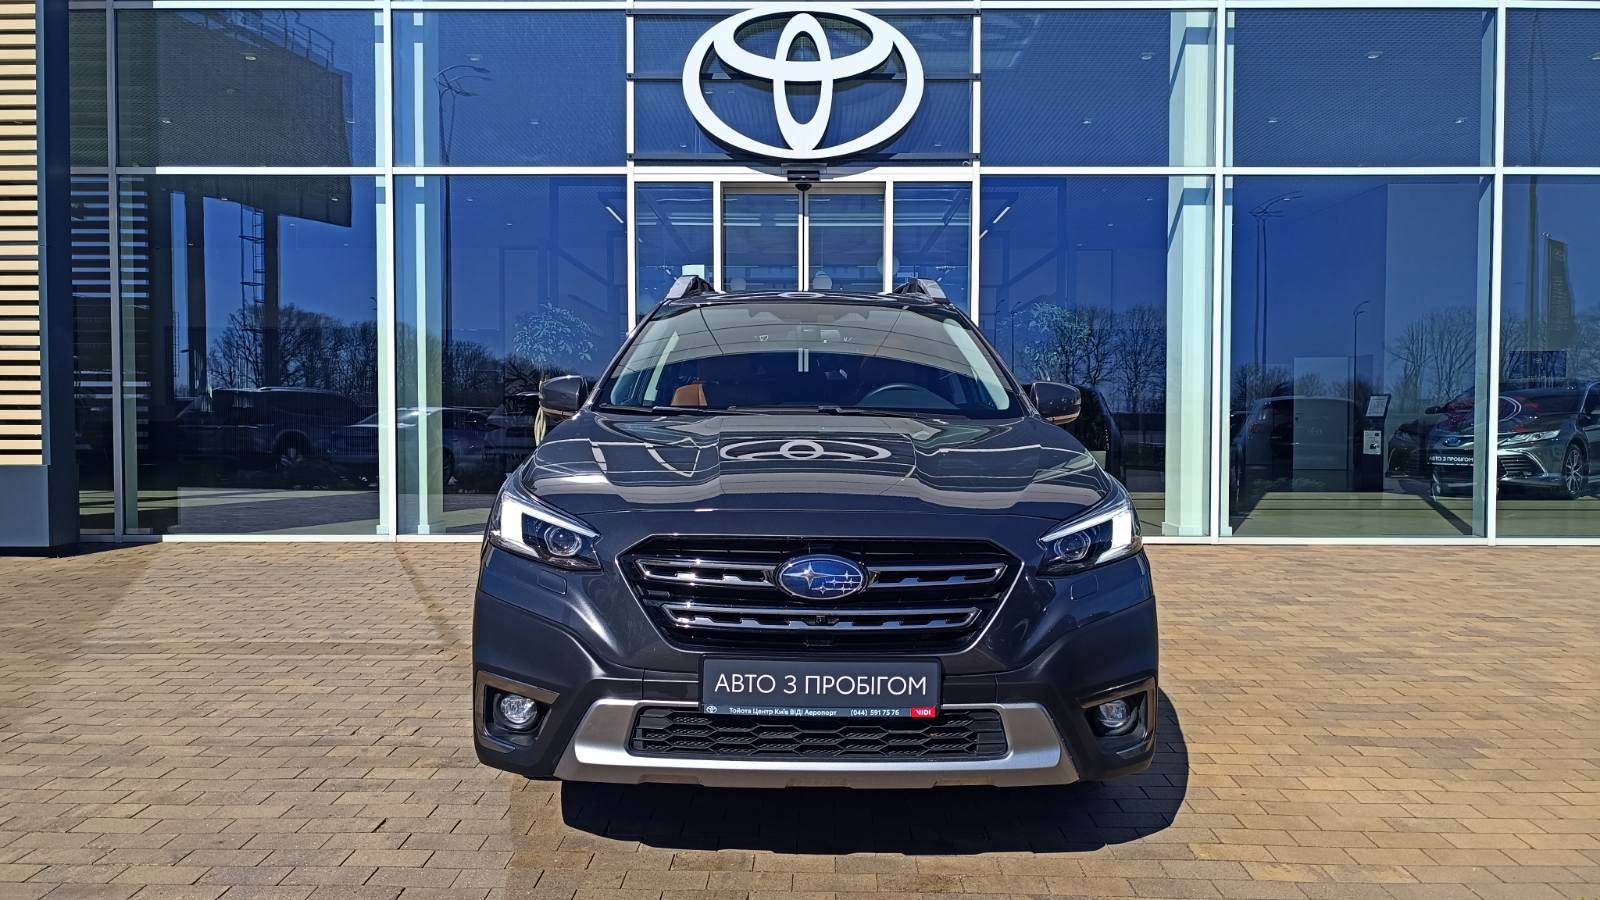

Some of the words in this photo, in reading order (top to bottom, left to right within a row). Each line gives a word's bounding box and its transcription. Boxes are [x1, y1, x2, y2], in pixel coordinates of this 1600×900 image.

[714, 673, 776, 693] АВТО
[783, 675, 797, 694] З
[804, 675, 927, 696] ПРОБІГОМ
[752, 708, 773, 716] Центр
[774, 707, 789, 715] Київ
[804, 708, 837, 716] Аеропорт
